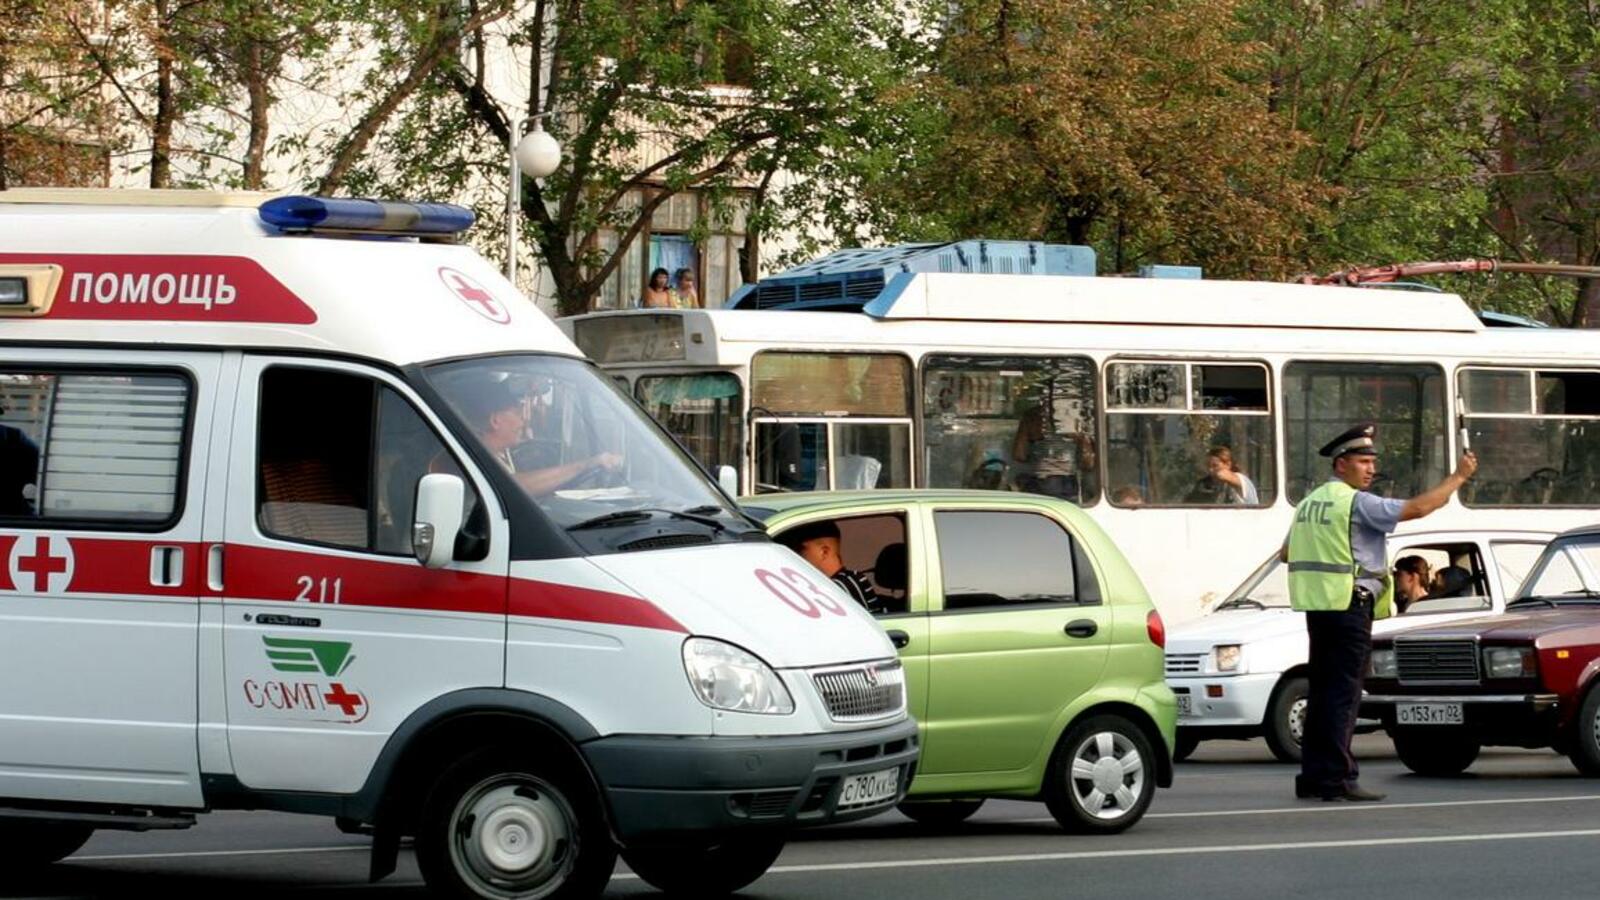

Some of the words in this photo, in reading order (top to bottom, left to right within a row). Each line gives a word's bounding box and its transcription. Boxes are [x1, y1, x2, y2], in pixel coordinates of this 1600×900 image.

[70, 272, 236, 310] ПОМОЩЬ
[1296, 500, 1334, 525] ДПС
[295, 575, 341, 604] 211
[754, 567, 847, 618] 03
[244, 679, 326, 711] ССМП
